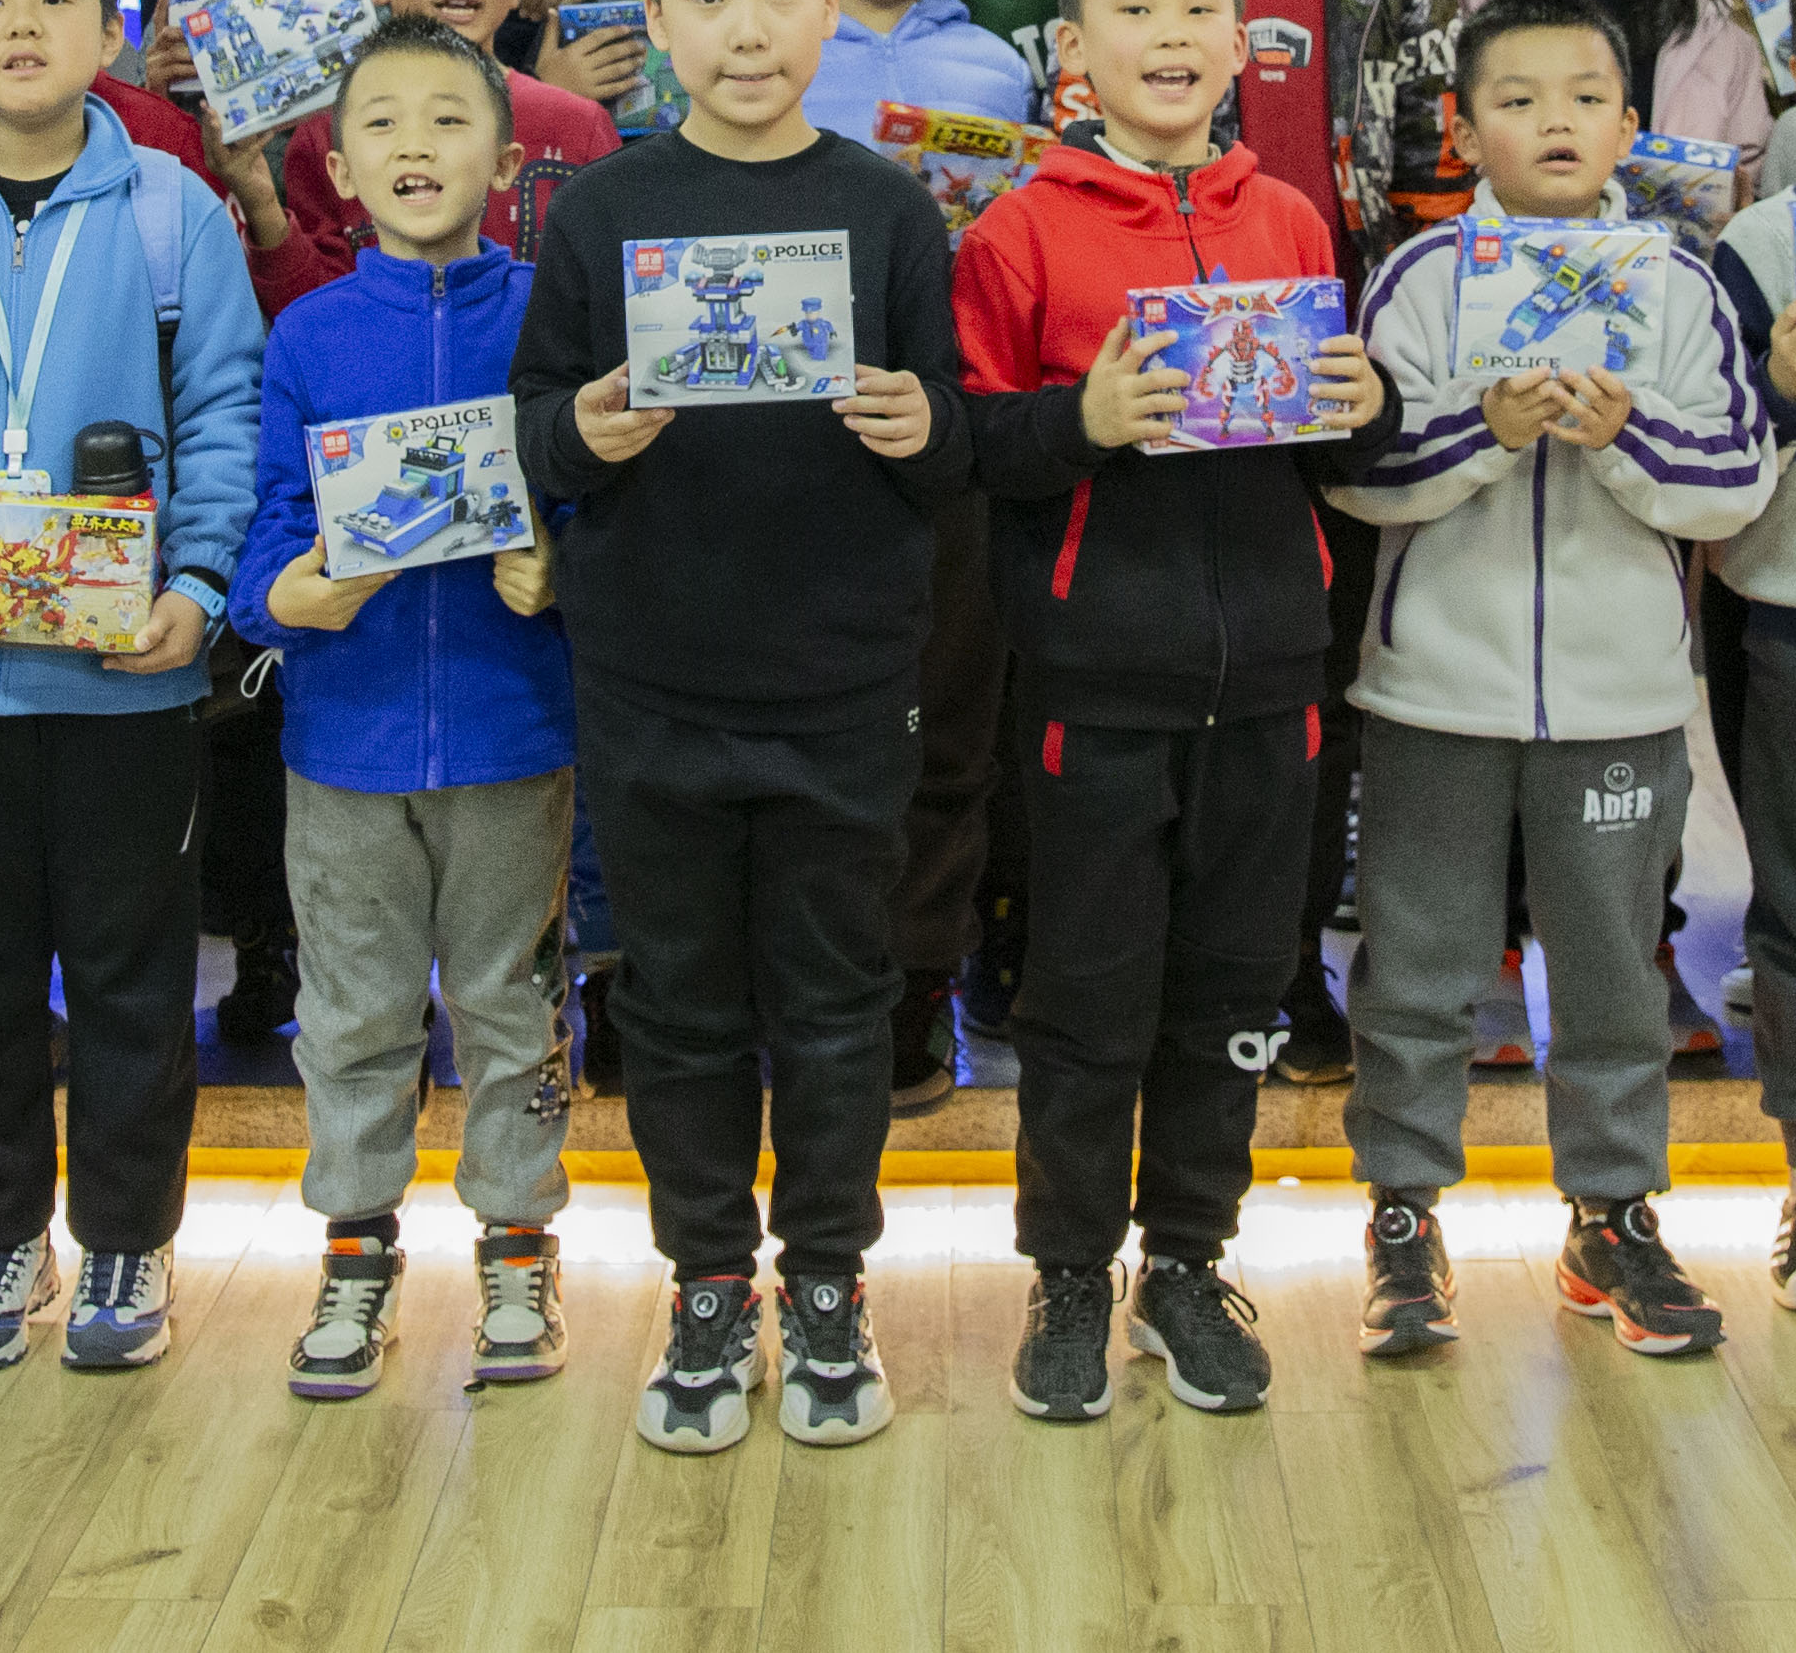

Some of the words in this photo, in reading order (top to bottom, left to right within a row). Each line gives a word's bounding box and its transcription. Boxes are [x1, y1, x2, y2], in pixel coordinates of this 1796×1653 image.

[773, 242, 843, 258] POLICE
[409, 406, 492, 433] POLICE
[1581, 786, 1652, 824] ADER
